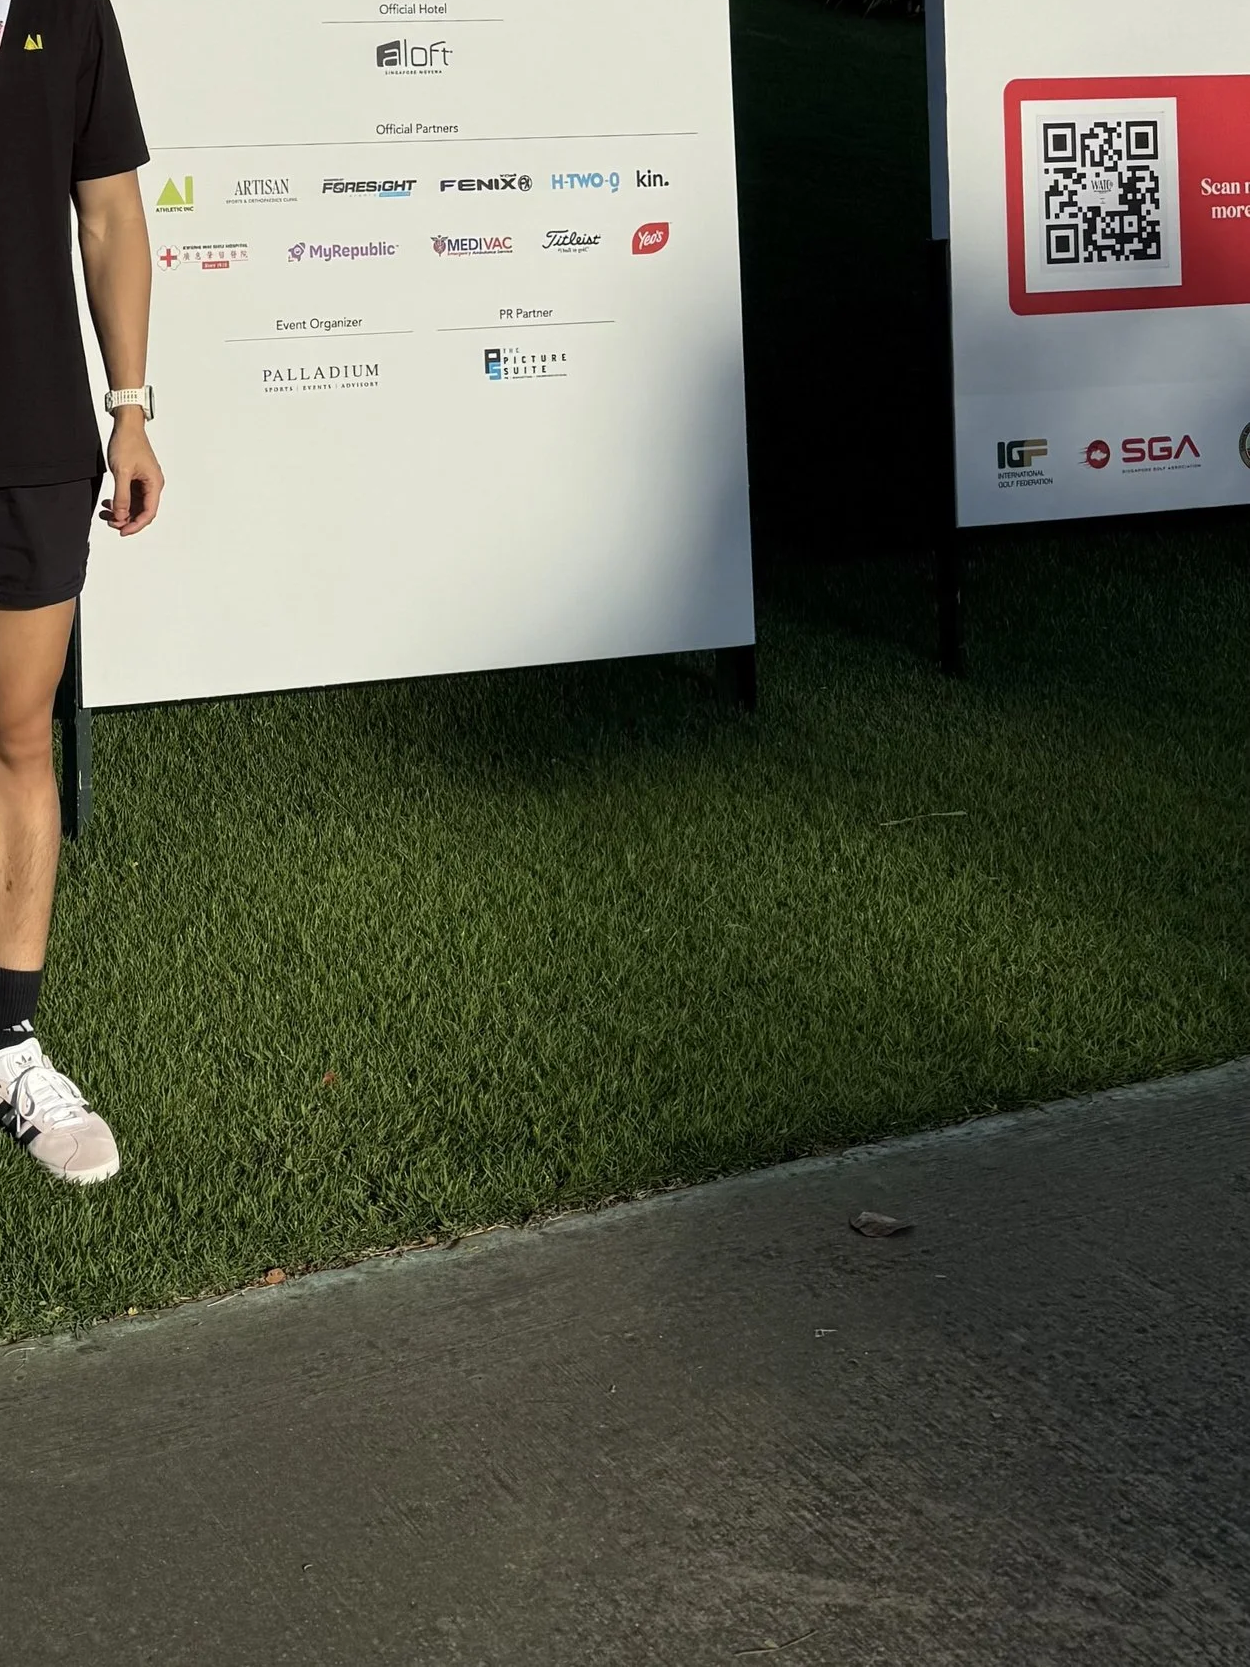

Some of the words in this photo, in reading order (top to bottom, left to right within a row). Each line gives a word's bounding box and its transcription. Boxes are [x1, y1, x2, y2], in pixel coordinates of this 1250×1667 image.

[379, 3, 416, 15] Official
[419, 3, 446, 14] Hotel
[377, 39, 451, 67] aloft
[376, 123, 412, 135] Official
[416, 123, 458, 133] Partners
[440, 178, 516, 192] FENIX
[636, 169, 669, 187] kin.
[234, 179, 288, 195] ARTISAN
[1201, 178, 1240, 196] Scan
[447, 237, 512, 251] MEDIVAC
[542, 229, 601, 249] Titleist
[638, 230, 664, 250] Yeo's
[310, 242, 395, 262] MyRepublic
[500, 309, 513, 319] PR
[516, 309, 553, 318] Partner
[276, 320, 306, 330] Event
[310, 317, 362, 331] Organizer
[504, 353, 566, 364] PICTURE
[263, 364, 378, 382] PALLADIUM
[504, 365, 546, 375] SUITE
[997, 438, 1048, 469] IGF
[998, 470, 1044, 479] INTERNATIONAL
[1016, 478, 1053, 487] FEDERATION
